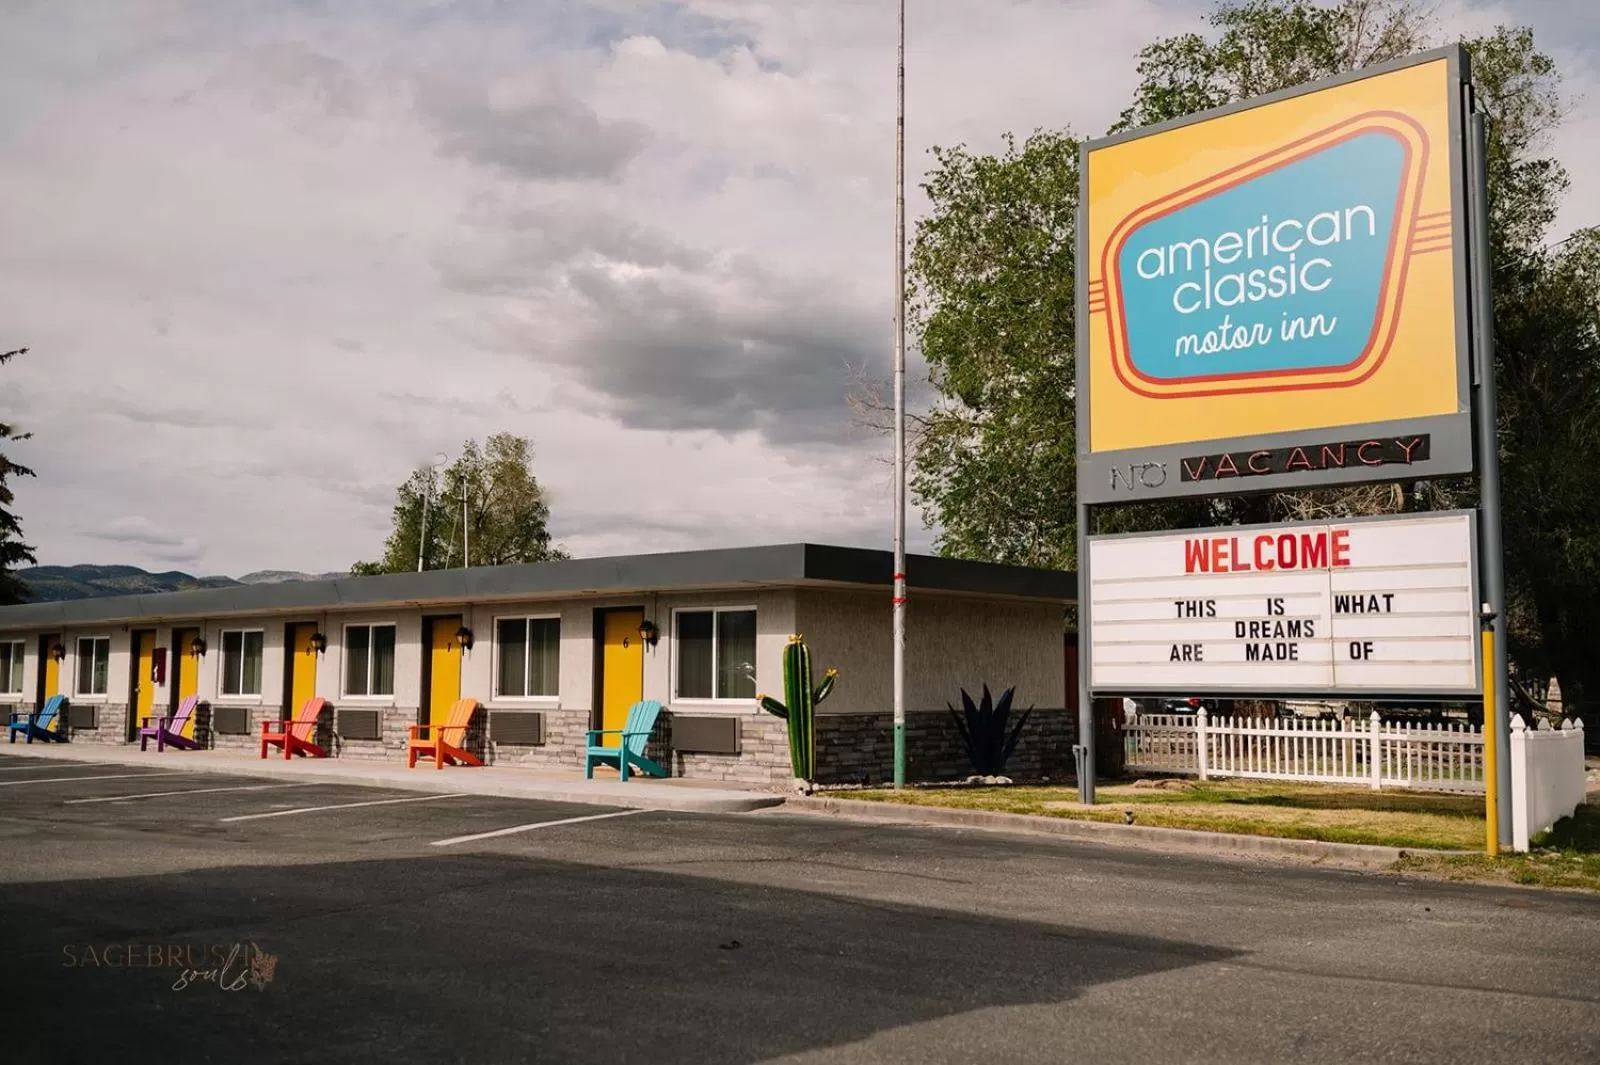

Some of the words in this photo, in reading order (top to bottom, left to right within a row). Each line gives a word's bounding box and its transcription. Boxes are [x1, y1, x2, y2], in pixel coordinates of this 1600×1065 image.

[1136, 205, 1376, 279] american
[1172, 254, 1333, 314] classic
[1174, 315, 1272, 358] motor
[1280, 312, 1338, 340] inn
[1110, 461, 1167, 491] NO
[1183, 437, 1420, 482] VACANCY
[1185, 530, 1350, 573] WELCOME
[1174, 600, 1217, 619] THIS
[1266, 598, 1285, 616] IS
[1334, 594, 1395, 614] WHAT
[622, 637, 630, 649] 6
[1235, 620, 1315, 639] DREAMS
[1169, 644, 1204, 662] ARE
[1245, 642, 1299, 662] MADE
[1349, 641, 1374, 661] OF
